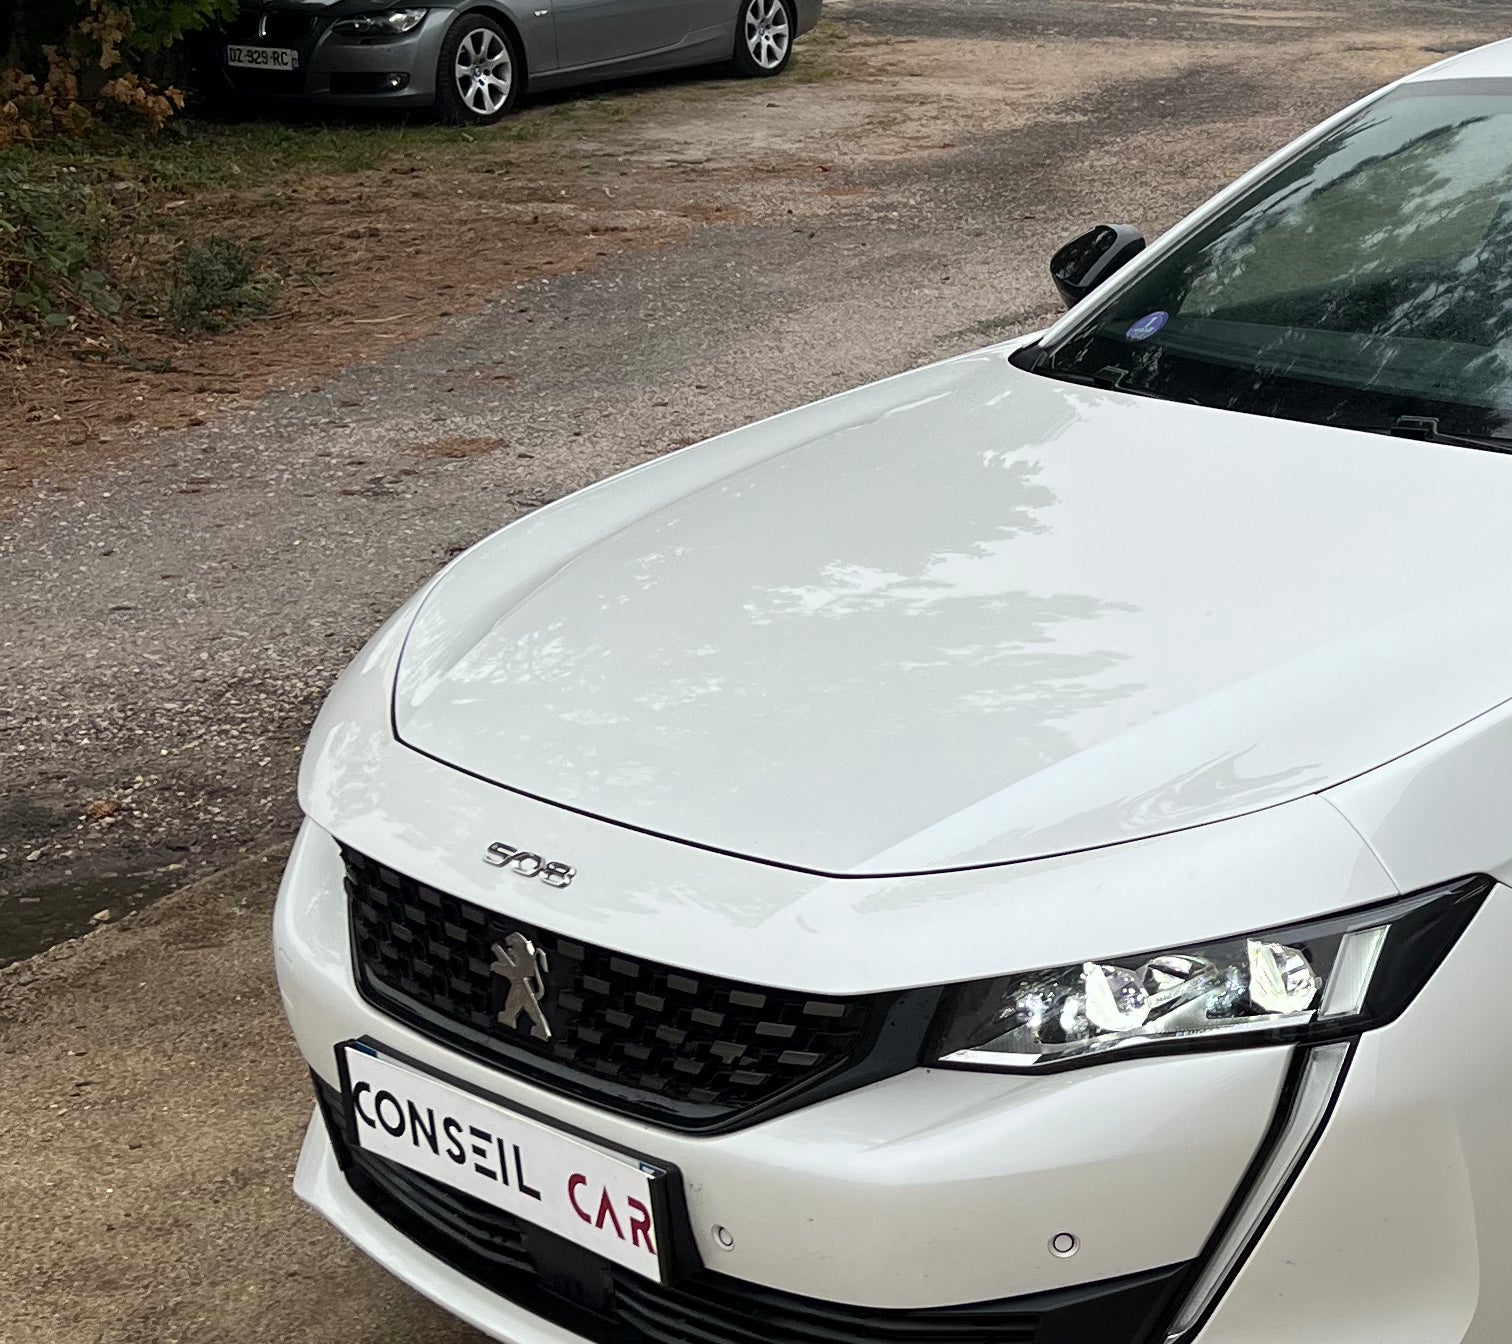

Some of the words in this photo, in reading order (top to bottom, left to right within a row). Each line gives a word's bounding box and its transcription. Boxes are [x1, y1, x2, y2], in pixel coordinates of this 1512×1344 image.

[482, 842, 577, 889] 508
[353, 1081, 541, 1201] CONSEIL
[568, 1172, 657, 1256] CAR
